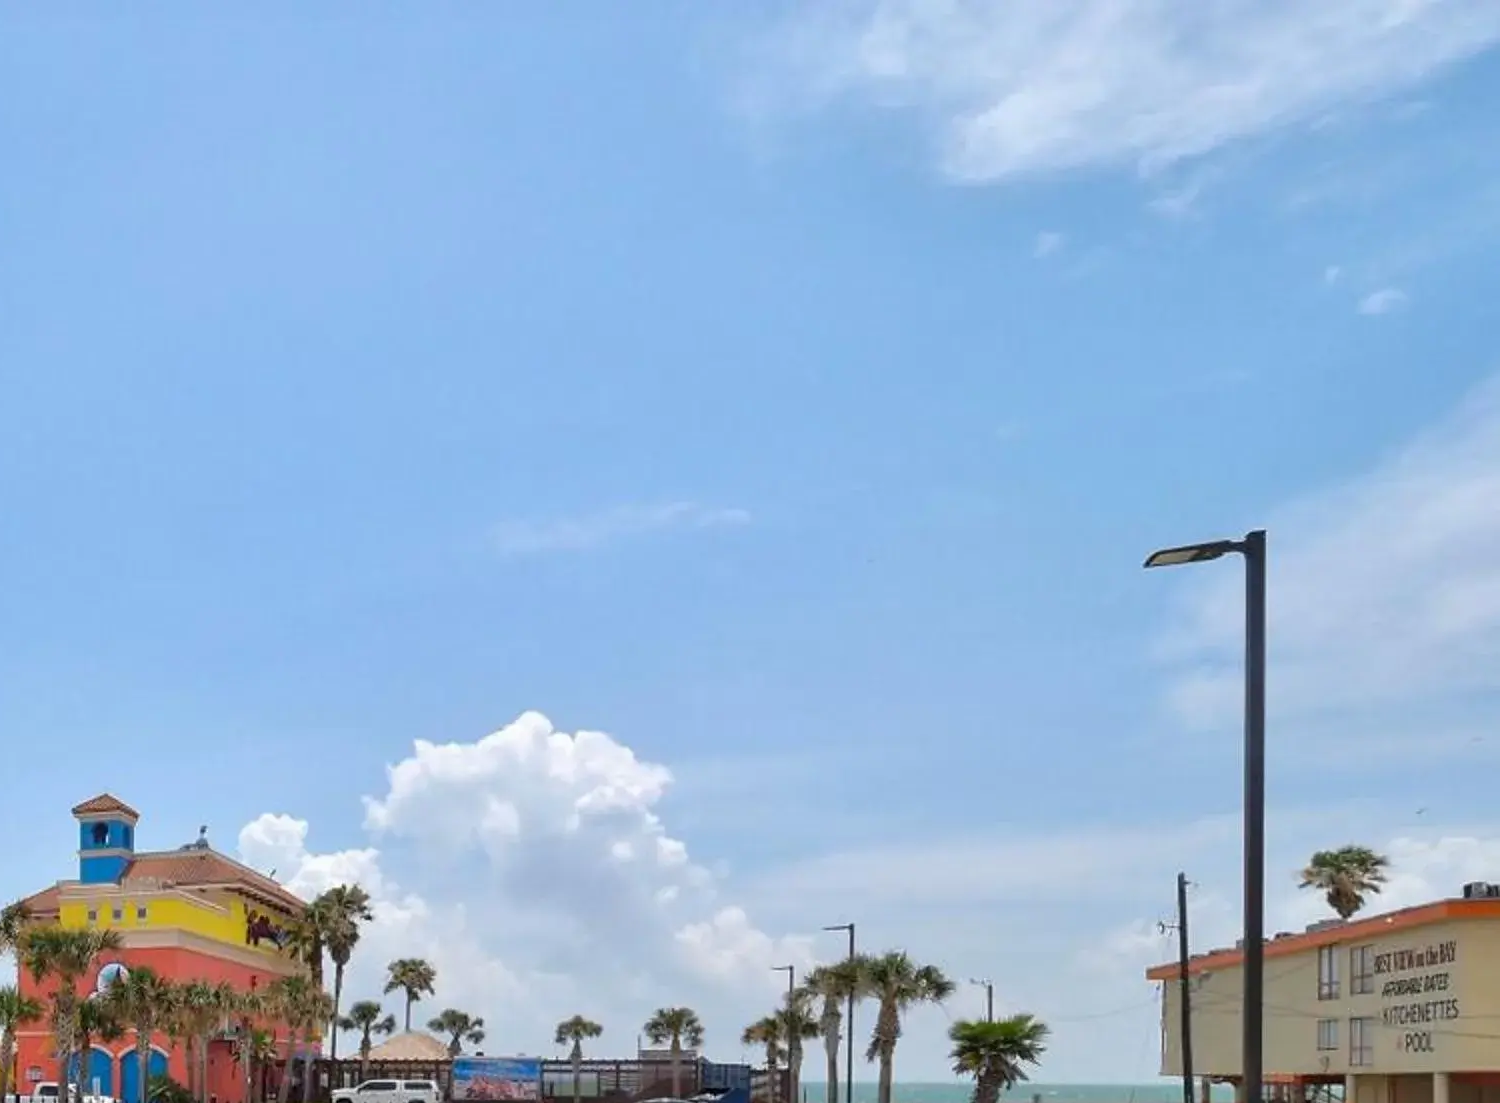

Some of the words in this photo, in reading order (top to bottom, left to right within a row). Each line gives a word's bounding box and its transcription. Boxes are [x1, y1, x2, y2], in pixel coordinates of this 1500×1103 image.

[1439, 940, 1456, 964] BAY
[1383, 998, 1459, 1025] KITCHENETTES
[1405, 1032, 1434, 1053] POOL
